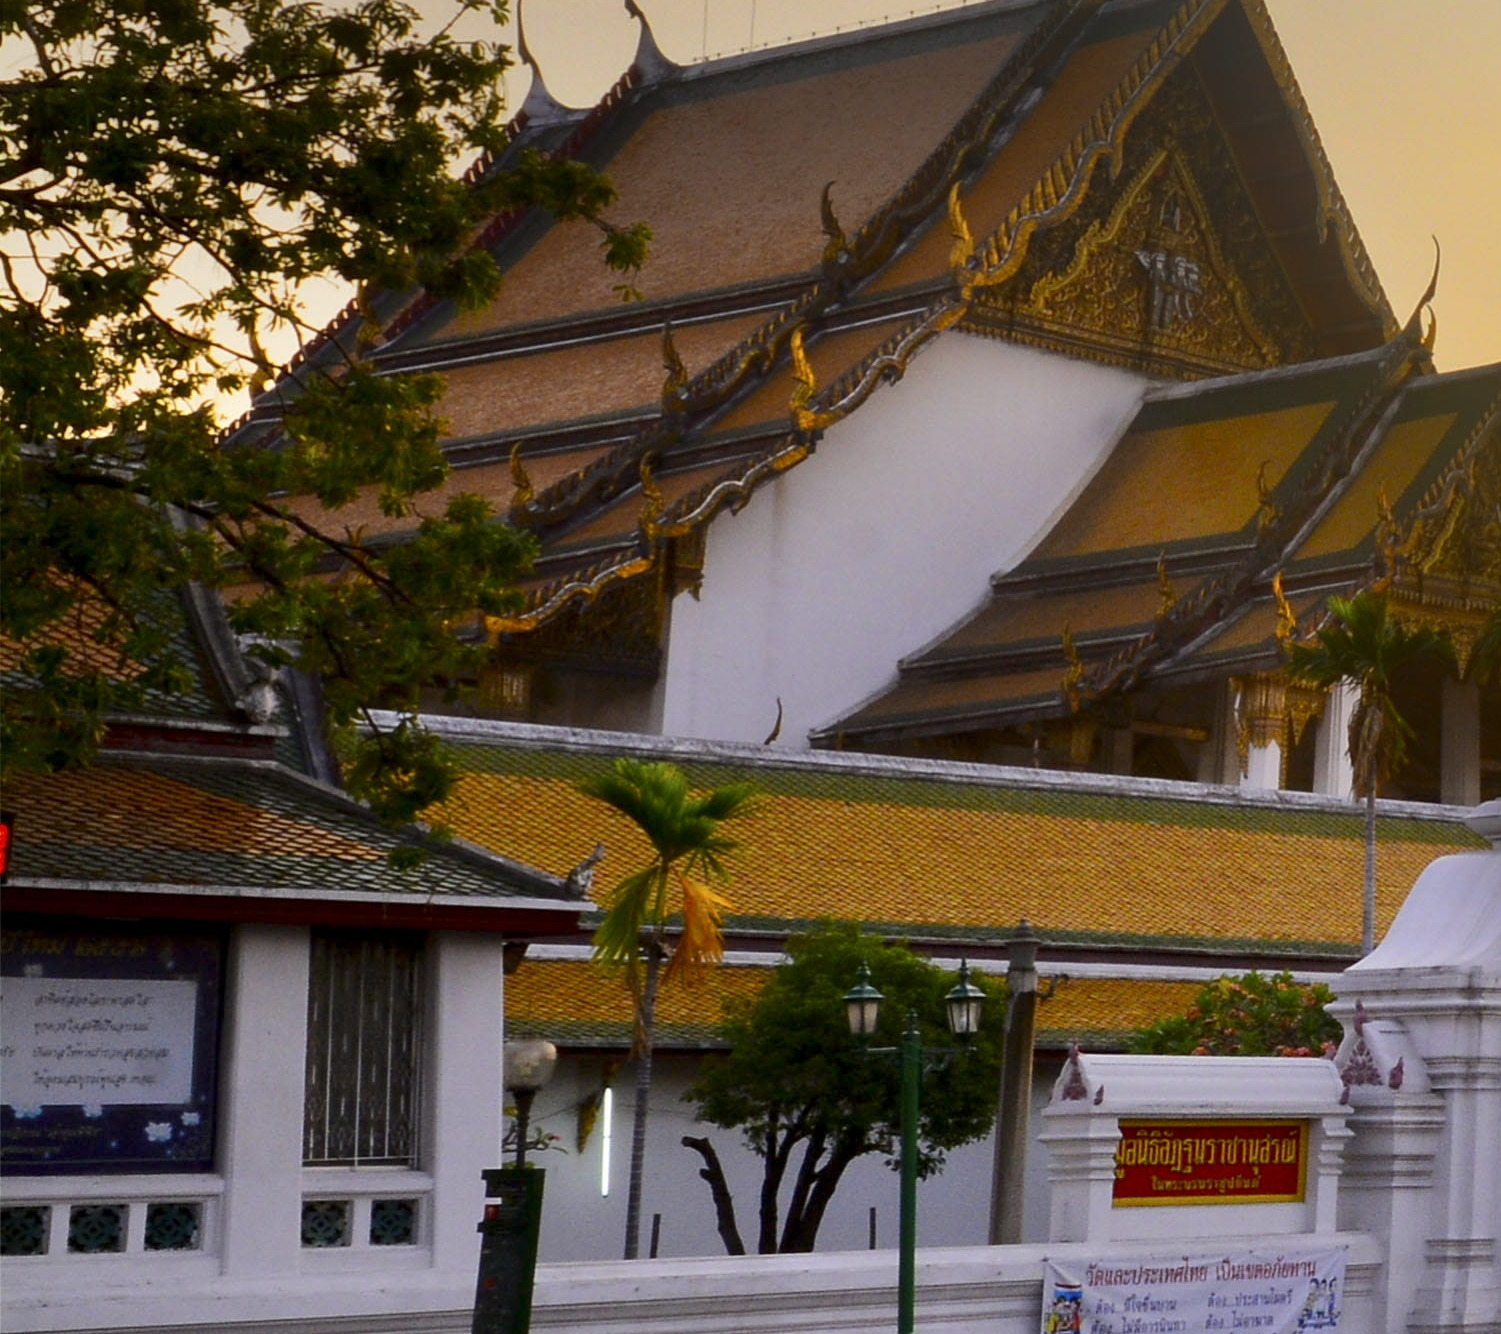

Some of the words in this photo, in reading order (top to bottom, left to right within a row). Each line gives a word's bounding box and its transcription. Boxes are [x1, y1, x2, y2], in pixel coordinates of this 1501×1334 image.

[1085, 1257, 1208, 1288] วัดและประเทศไทย
[1215, 1257, 1316, 1283] เป็นเขตอภัยทาน
